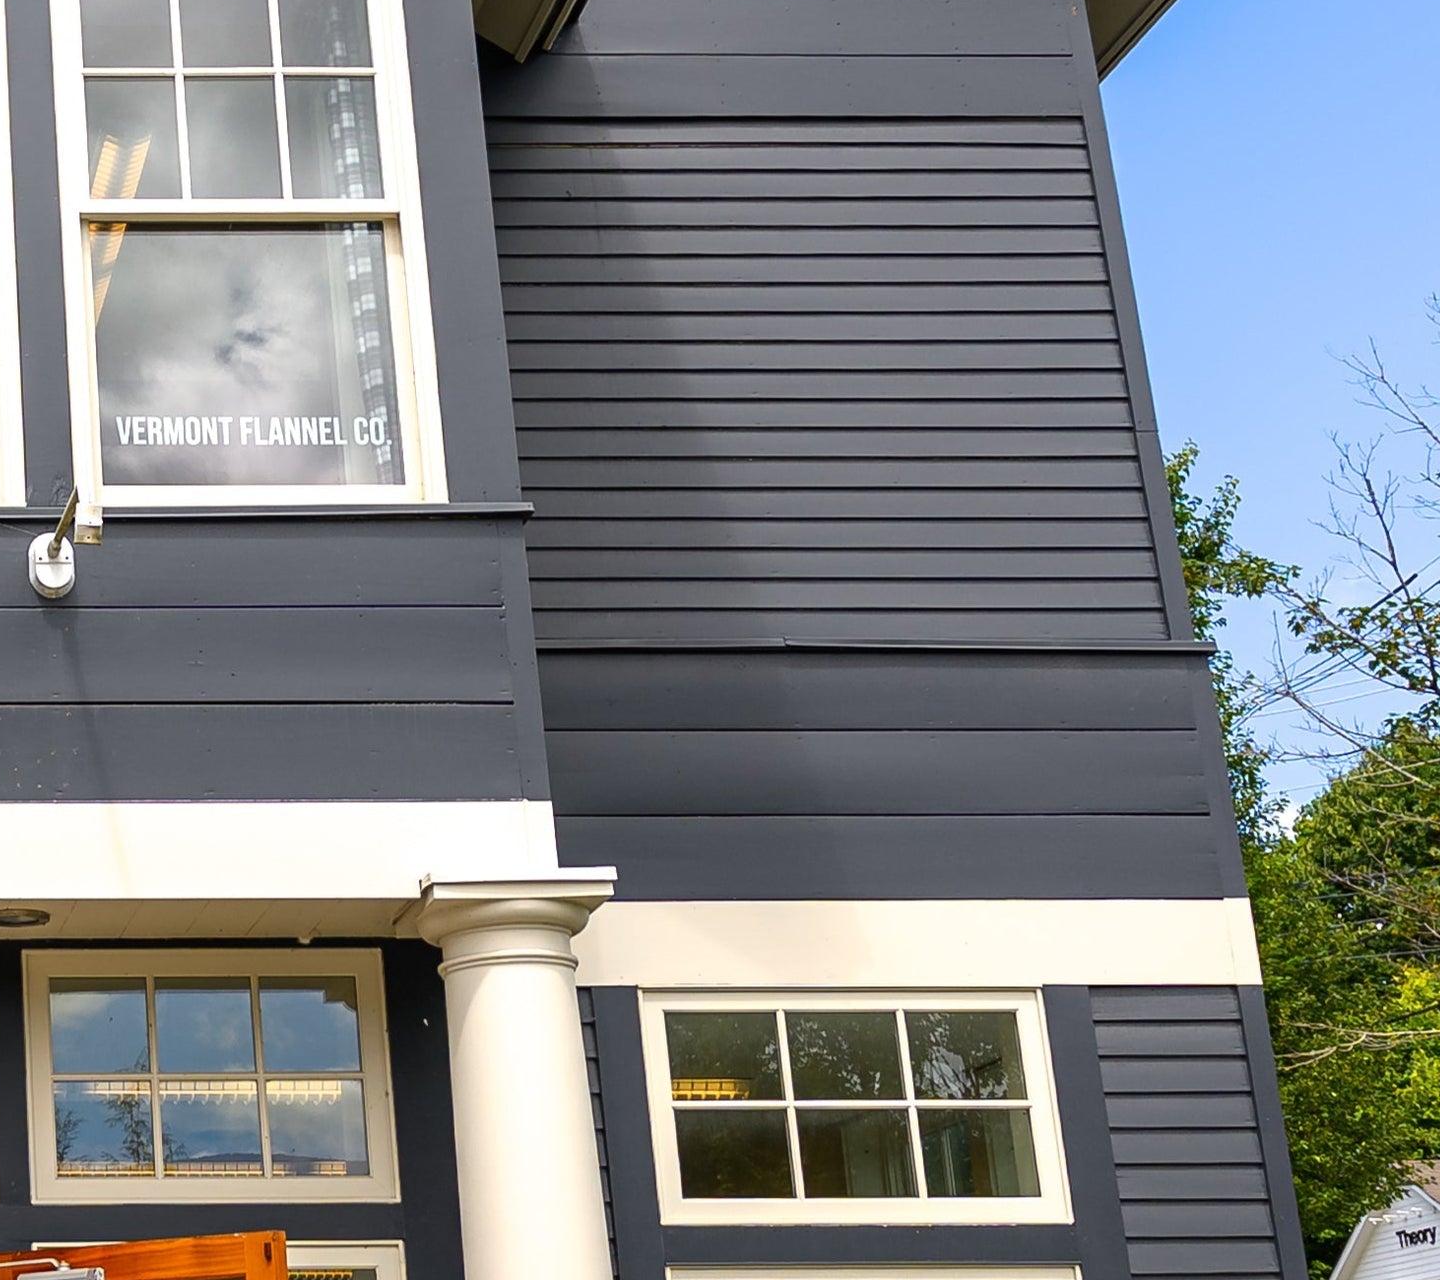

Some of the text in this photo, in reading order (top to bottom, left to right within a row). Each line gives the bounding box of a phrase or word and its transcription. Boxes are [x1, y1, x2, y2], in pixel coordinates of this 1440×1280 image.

[116, 415, 393, 446] VERMONT FLANNEL CO.
[1395, 1226, 1437, 1248] Theory
